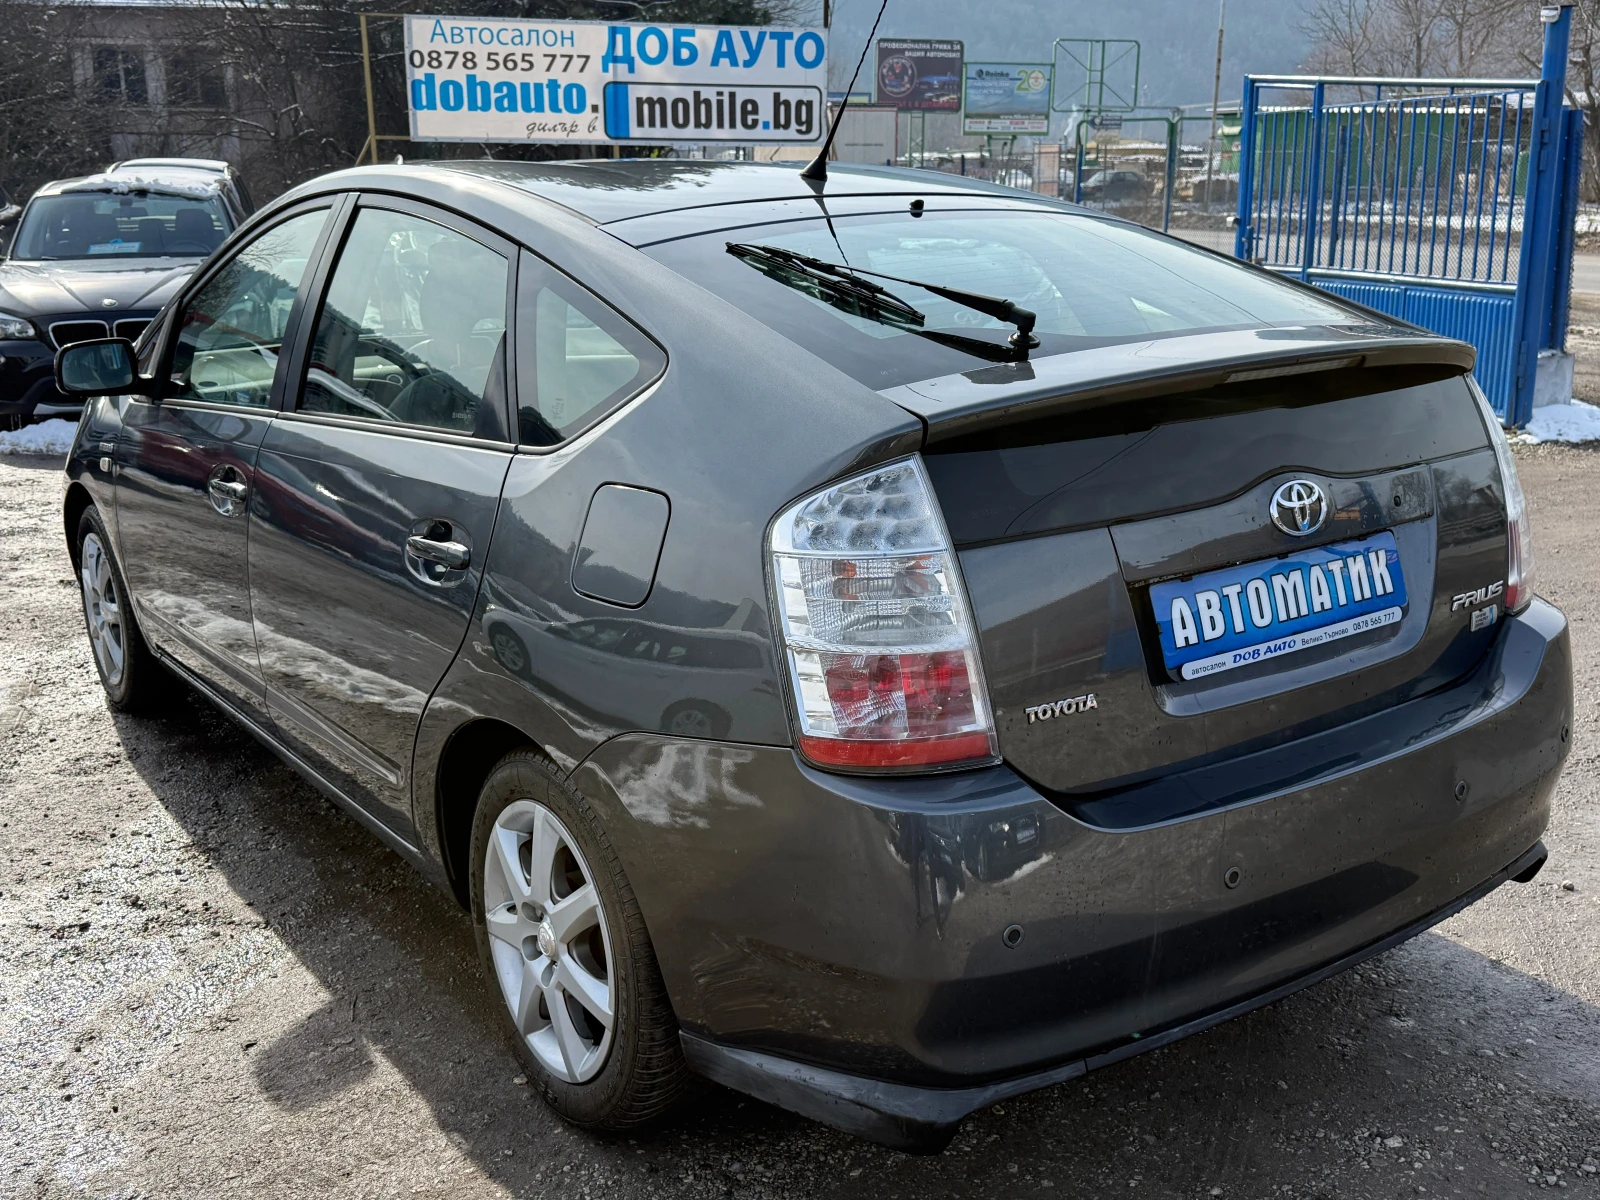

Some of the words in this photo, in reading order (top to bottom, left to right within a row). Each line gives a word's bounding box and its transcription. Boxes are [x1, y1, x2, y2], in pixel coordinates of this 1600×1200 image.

[430, 19, 575, 47] Автосалон
[601, 26, 699, 74] ДОБ
[709, 29, 825, 69] АУТО
[409, 50, 478, 70] 0878
[486, 52, 535, 72] 565
[543, 53, 591, 73] 777
[411, 72, 599, 114] dobauto.
[526, 119, 580, 139] дилър
[587, 116, 599, 134] в
[635, 90, 814, 135] mobile.bg
[1170, 549, 1394, 649] АВТОМАТИК
[1452, 580, 1504, 612] PRIUS
[1191, 660, 1227, 676] автосалон
[1232, 649, 1261, 664] DOB
[1301, 634, 1324, 646] Велико
[1324, 627, 1349, 642] Търново
[1352, 620, 1370, 632] 0878
[1370, 616, 1382, 628] 565
[1383, 612, 1395, 624] 777
[1025, 693, 1098, 724] TOYOTA
